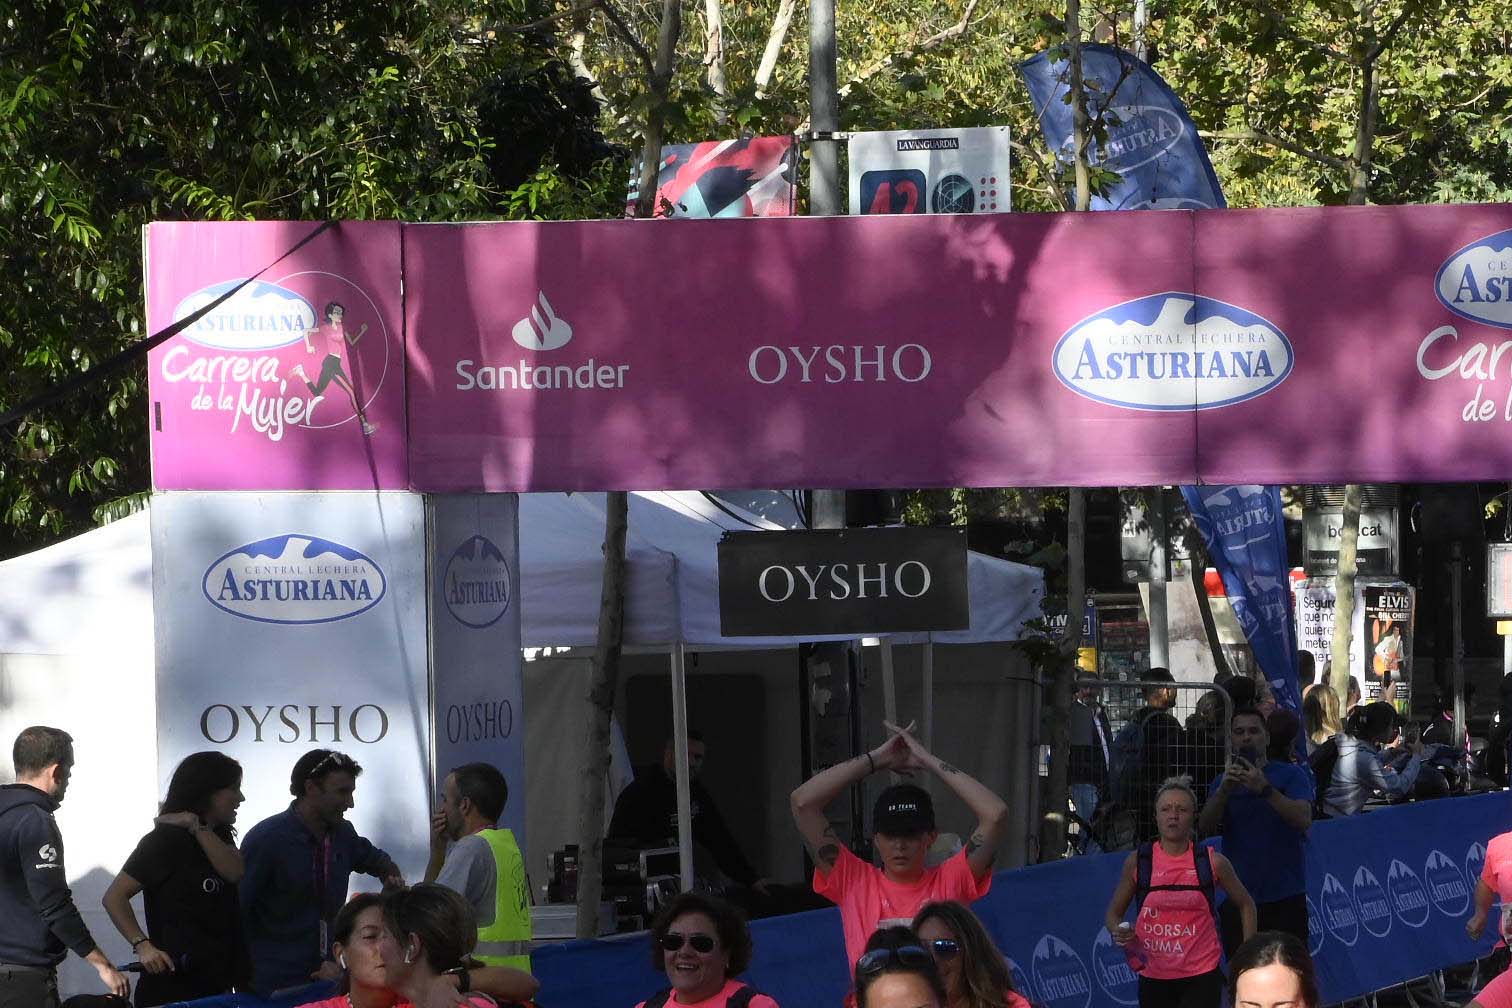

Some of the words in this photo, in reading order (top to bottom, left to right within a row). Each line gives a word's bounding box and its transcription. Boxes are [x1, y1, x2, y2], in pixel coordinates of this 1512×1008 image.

[1109, 333, 1187, 345] CENTRAL
[1192, 331, 1267, 345] LECHERA
[161, 345, 280, 383] Carrera
[456, 358, 630, 391] Santander
[748, 342, 932, 385] OYSHO
[1073, 337, 1274, 381] ASTURIANA
[191, 384, 212, 411] de
[217, 384, 234, 411] la
[231, 379, 325, 441] Mujer
[1462, 383, 1496, 424] de
[218, 567, 373, 601] ASTURIANA
[245, 566, 302, 575] CENTRAL
[308, 565, 367, 575] LECHERA
[449, 570, 507, 605] ASTURIANA
[758, 560, 932, 602] OYSHO
[1379, 595, 1409, 608] ELVIS
[200, 703, 389, 744] OYSHO
[446, 699, 513, 744] OYSHO
[1143, 940, 1184, 954] SUMA
[1037, 969, 1089, 1002] ASTURIANA
